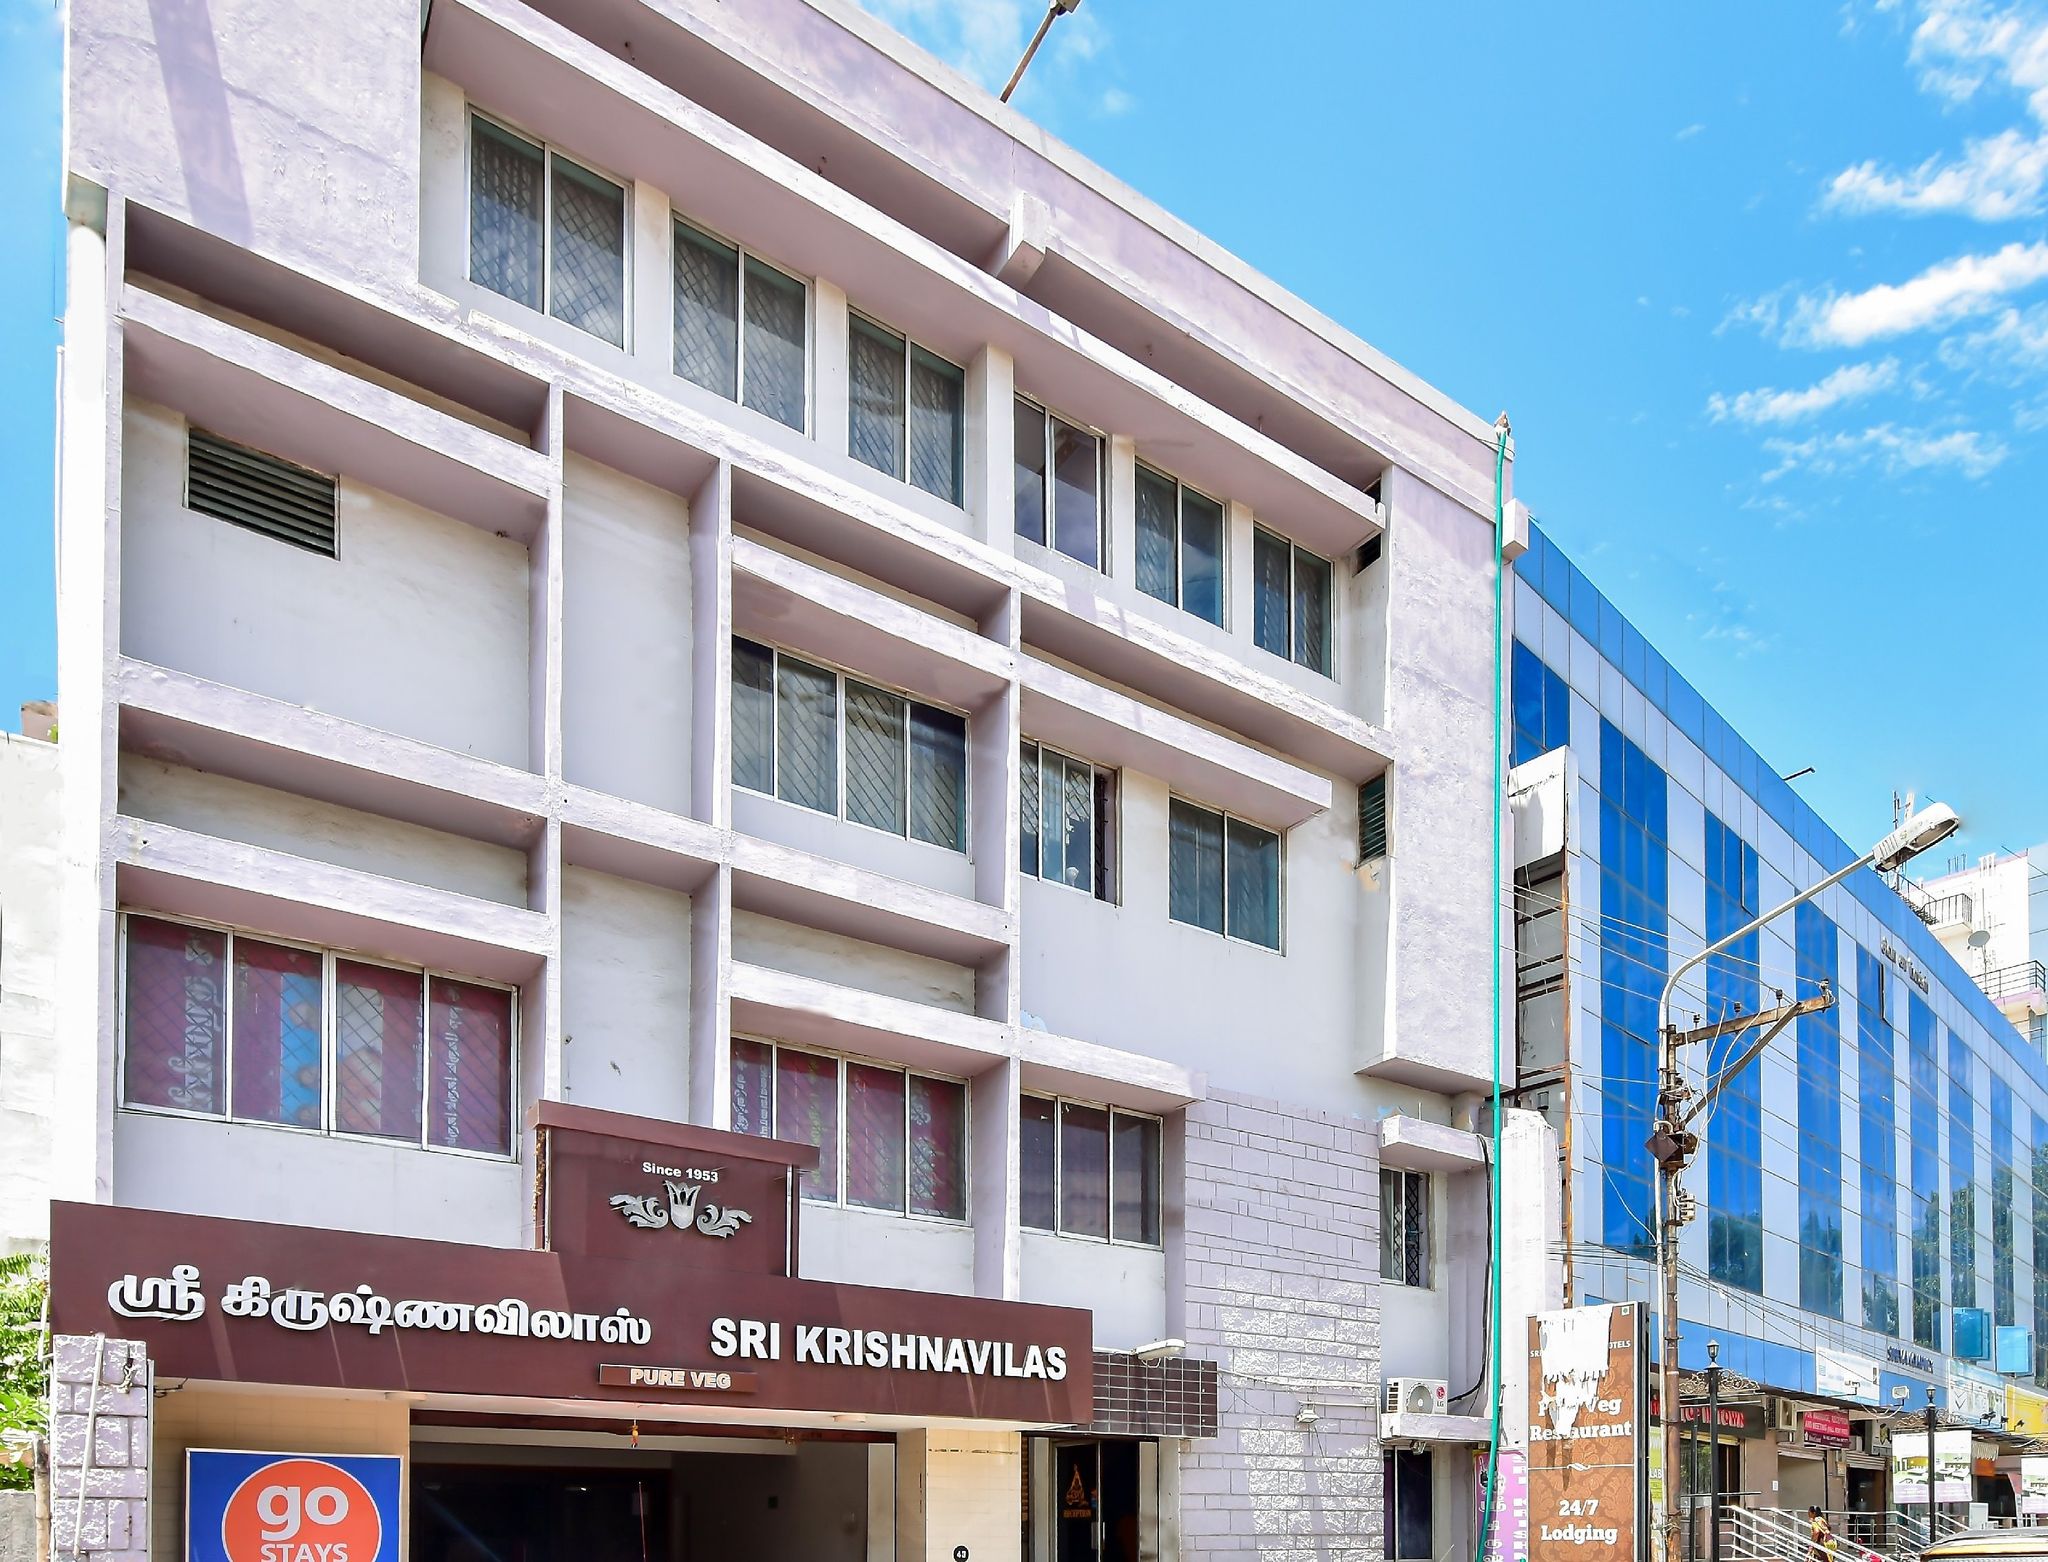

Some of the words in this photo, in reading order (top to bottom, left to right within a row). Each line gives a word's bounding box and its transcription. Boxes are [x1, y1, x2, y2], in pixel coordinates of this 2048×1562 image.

[642, 1161, 682, 1177] Since
[686, 1168, 719, 1183] 1953
[220, 1275, 653, 1346] கிருஷ்ணவிலாஸ்
[709, 1316, 781, 1361] SRI
[795, 1324, 1068, 1382] KRISHNAVILAS
[630, 1368, 685, 1387] PURE
[691, 1371, 732, 1389] VEG
[1530, 1421, 1632, 1441] Resaurant
[257, 1485, 349, 1541] go
[1559, 1499, 1599, 1516] 24/7
[1541, 1524, 1618, 1545] Lodging
[261, 1543, 349, 1562] STAYS
